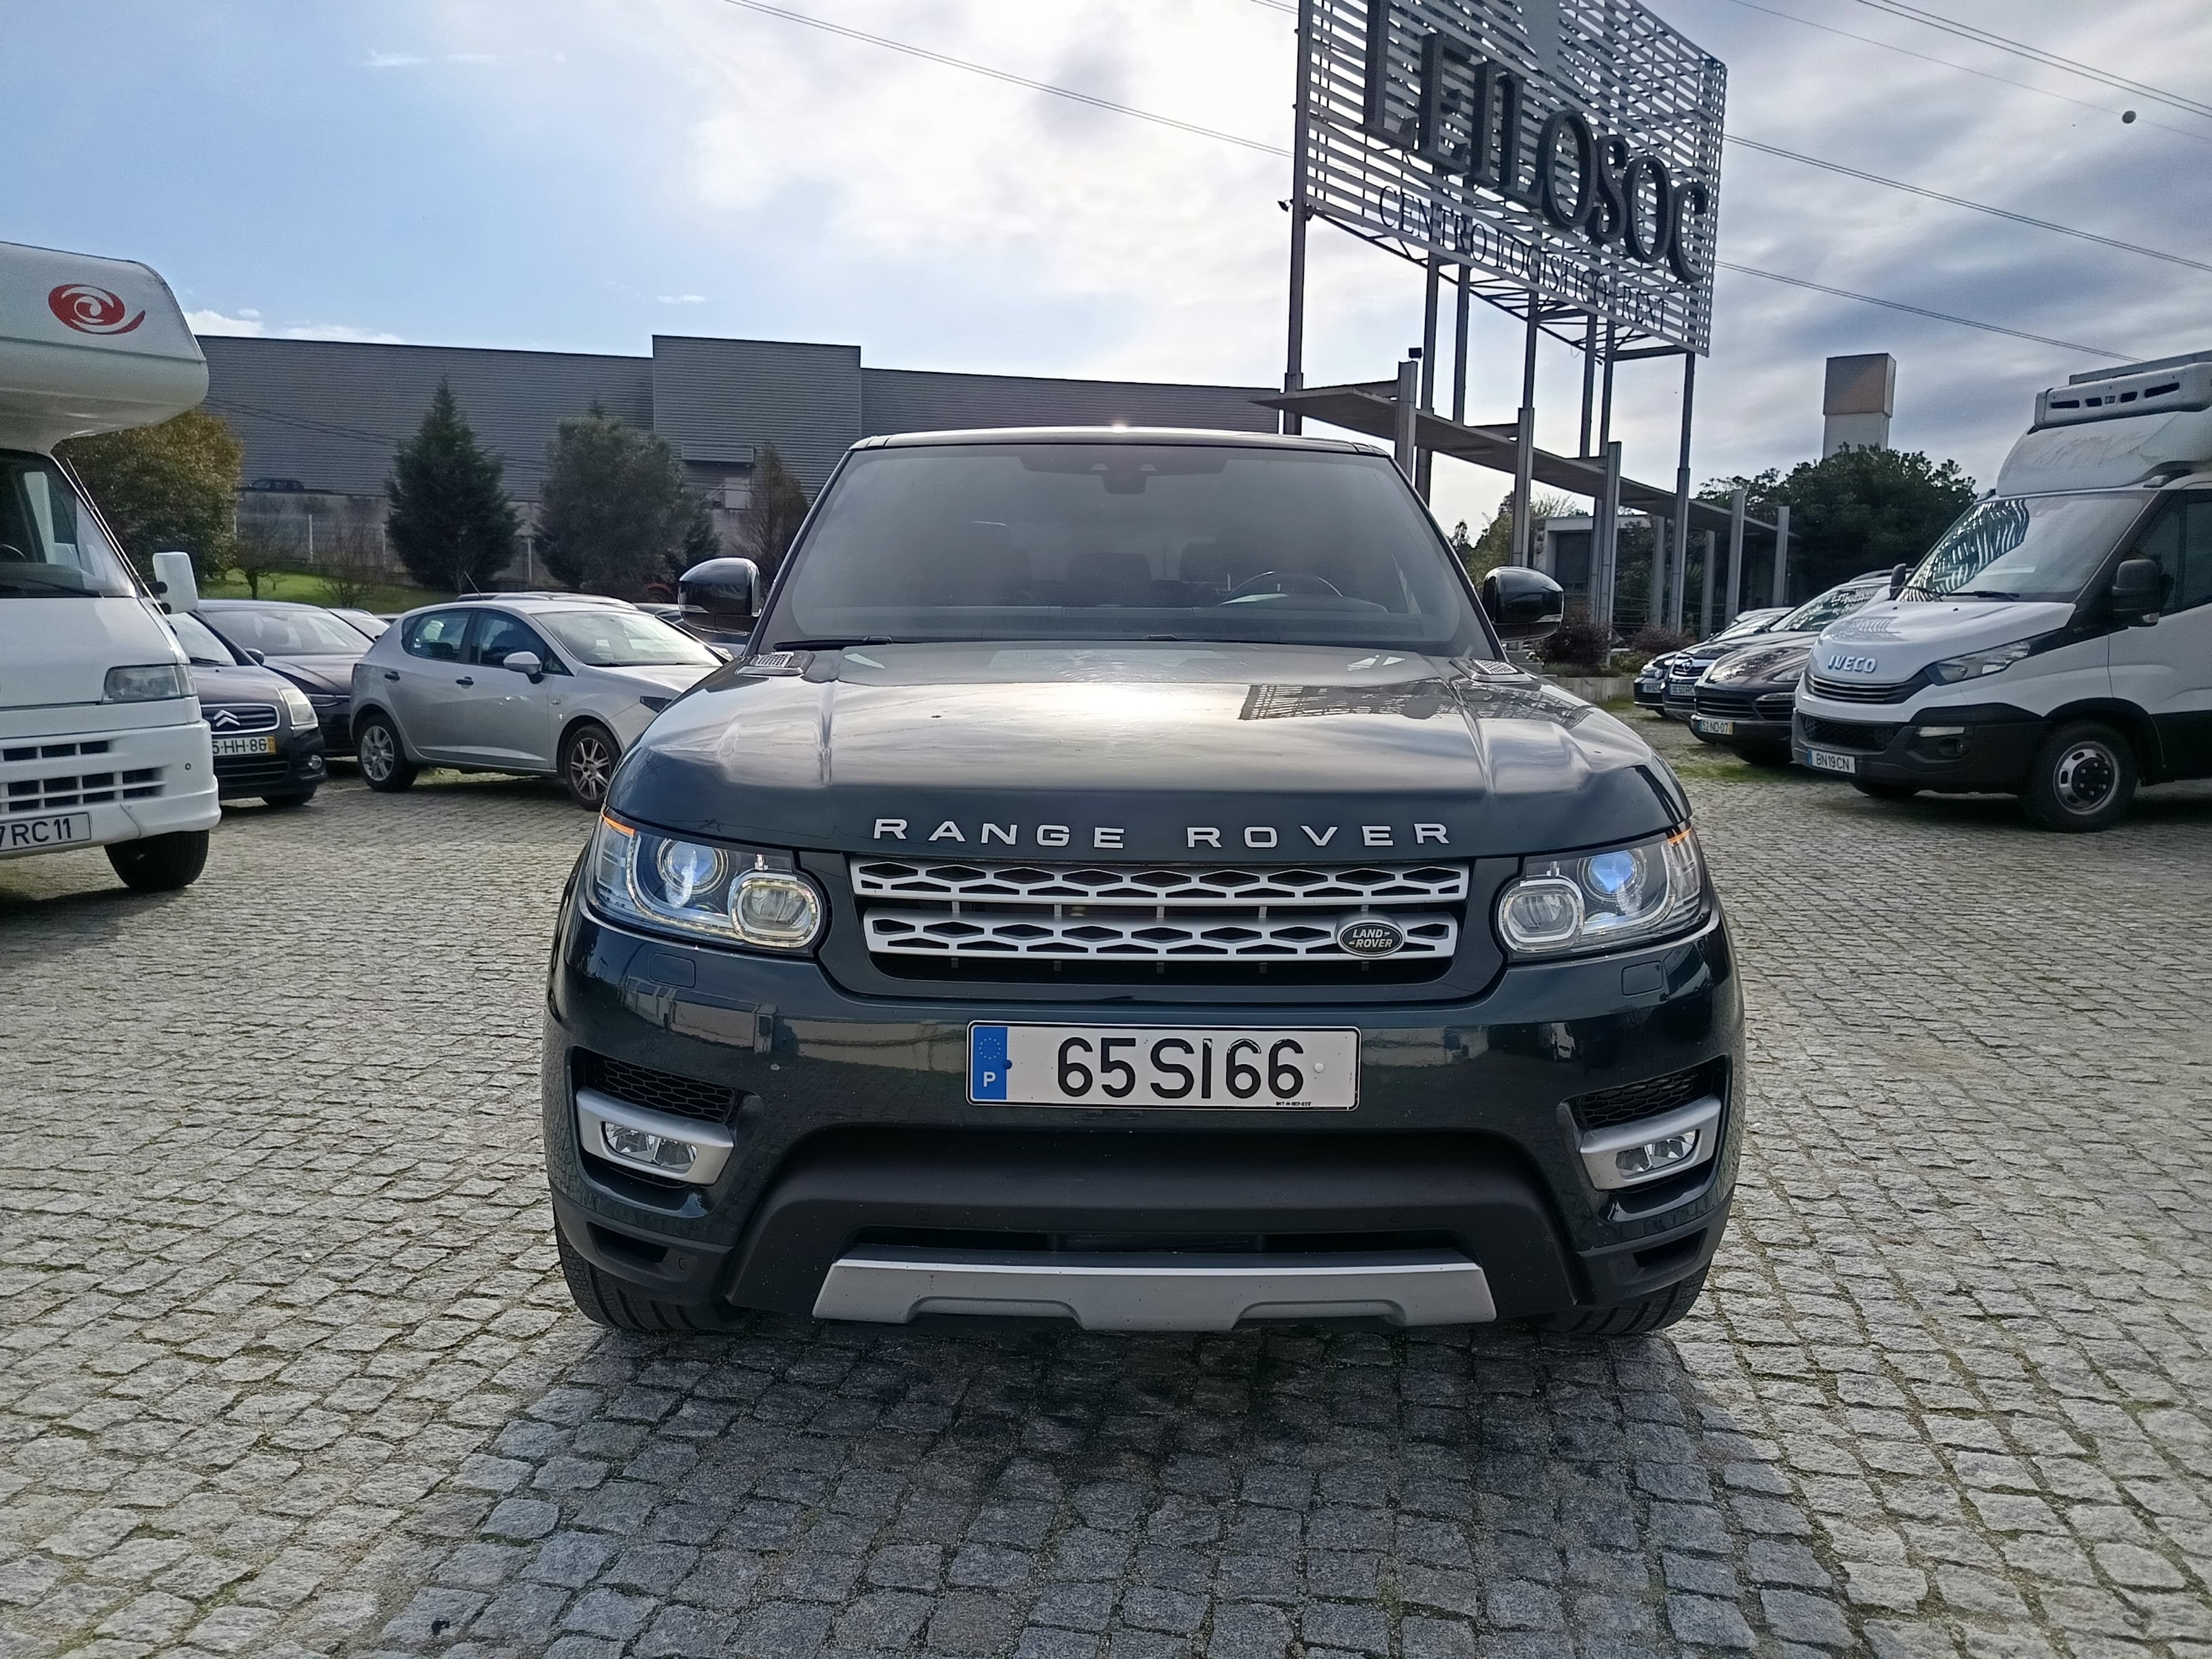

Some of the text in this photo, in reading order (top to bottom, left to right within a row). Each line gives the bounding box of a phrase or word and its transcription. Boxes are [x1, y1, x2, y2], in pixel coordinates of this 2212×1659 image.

[1355, 0, 1707, 284] LEILOSOC
[1378, 185, 1488, 262] CENTRO
[1828, 654, 1877, 673] IVECO
[873, 818, 1450, 849] RANGE ROVER
[1353, 929, 1383, 938] LAND
[1355, 938, 1393, 948] ROVER
[983, 1071, 996, 1087] P
